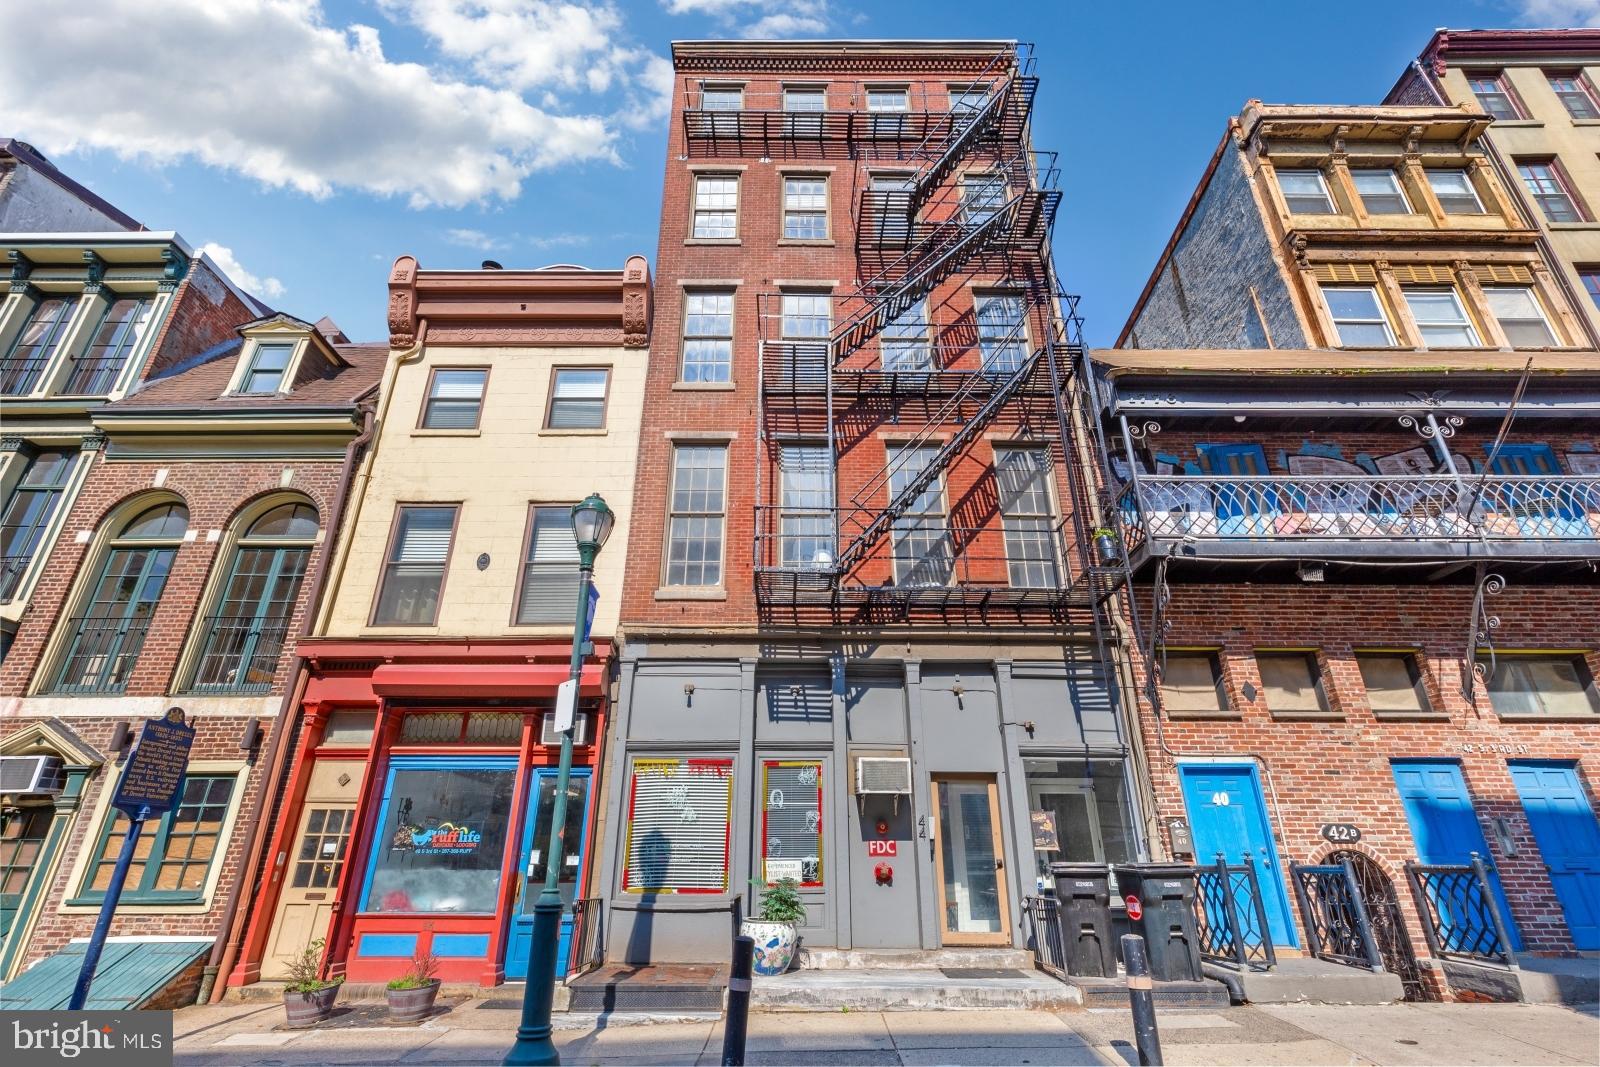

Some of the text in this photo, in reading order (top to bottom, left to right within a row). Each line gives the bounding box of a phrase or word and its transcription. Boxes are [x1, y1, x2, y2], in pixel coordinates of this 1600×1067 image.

[149, 725, 170, 733] ANTHONY
[1213, 792, 1230, 806] 40
[432, 830, 480, 842] ruff life
[870, 841, 895, 854] FDC
